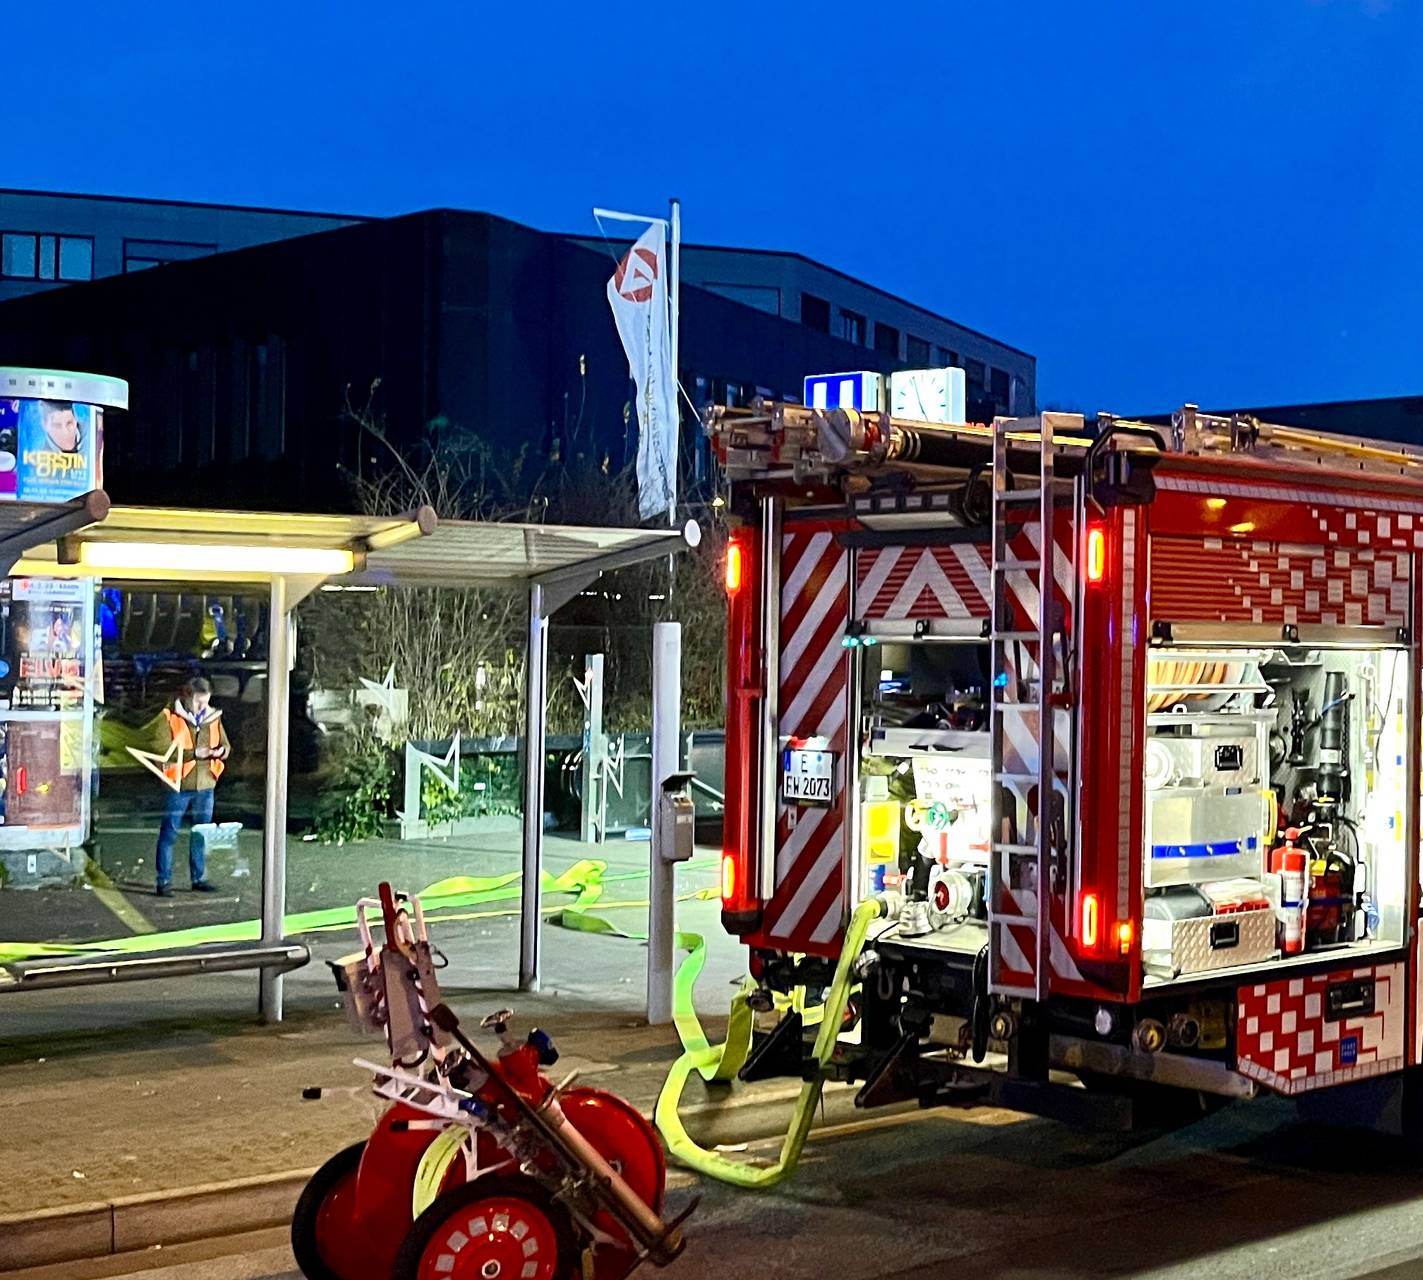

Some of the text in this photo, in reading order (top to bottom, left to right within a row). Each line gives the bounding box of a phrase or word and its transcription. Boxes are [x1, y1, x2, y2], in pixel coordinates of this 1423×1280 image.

[23, 450, 88, 469] KERSTIN
[802, 754, 808, 773] E
[786, 776, 830, 797] FW 2073
